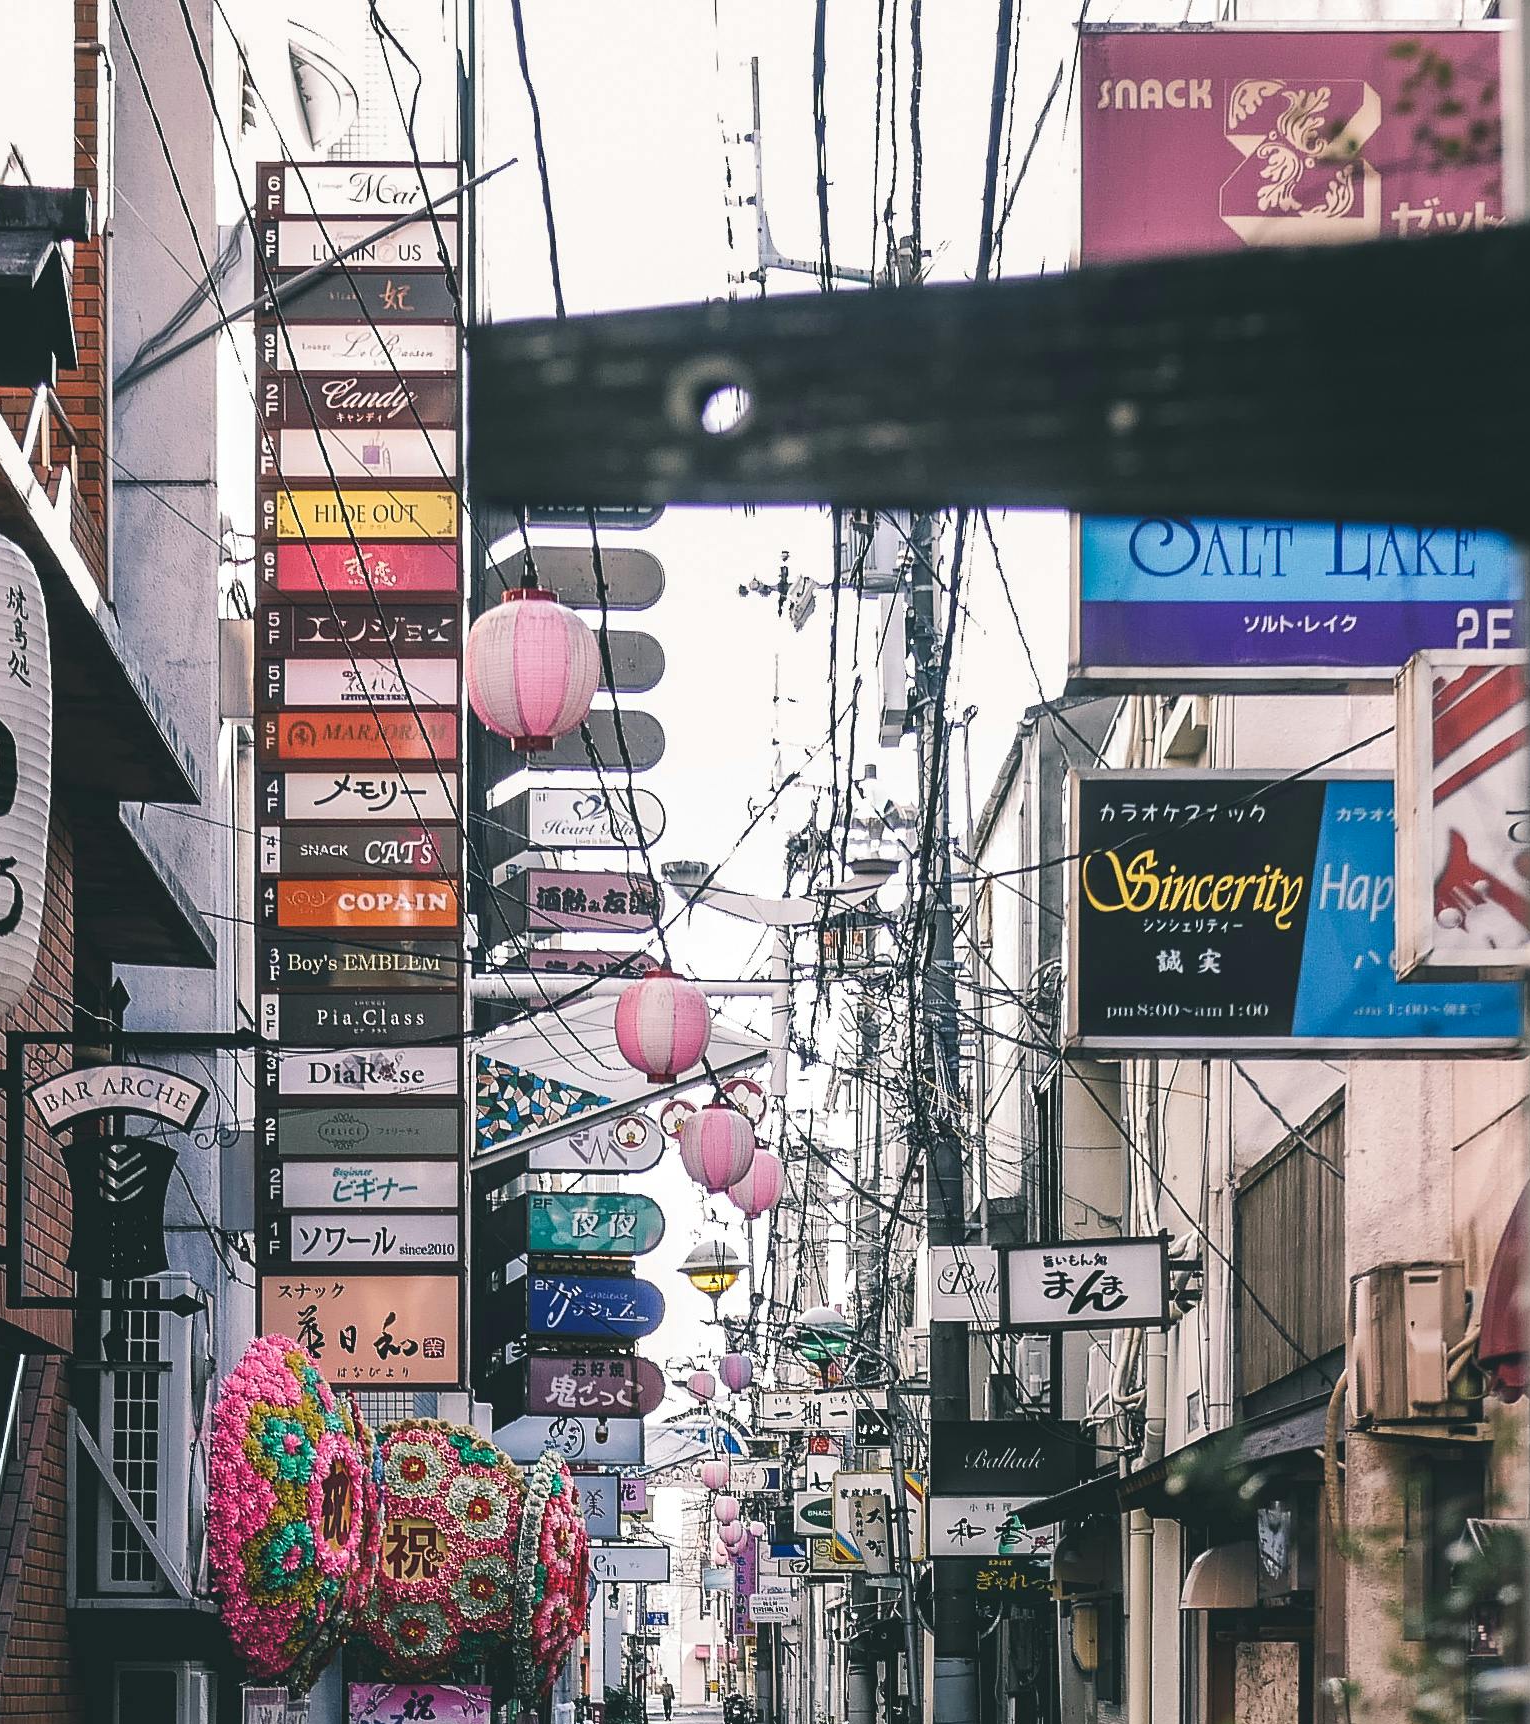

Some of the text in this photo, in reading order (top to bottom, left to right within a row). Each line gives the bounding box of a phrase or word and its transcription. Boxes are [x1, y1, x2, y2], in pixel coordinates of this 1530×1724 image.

[1098, 79, 1212, 110] SNACK
[348, 173, 420, 204] Mai
[321, 379, 419, 419] Candy
[315, 504, 418, 522] HIDE OUT
[1326, 521, 1477, 581] LAKE
[4, 586, 32, 688] 焼鳥処
[298, 617, 454, 642] エンジョイ
[1243, 615, 1357, 633] ソルト・レイク
[1456, 608, 1514, 649] 2F
[314, 775, 426, 811] メモリー
[300, 845, 348, 856] SNACK
[337, 893, 447, 912] COPAIN
[1083, 848, 1303, 931] Sincerity
[1144, 919, 1243, 933] シンシェリティー
[287, 954, 441, 974] Boy's EMBLEM
[1156, 948, 1222, 975] 誠実
[43, 1077, 190, 1112] BAR ARCHE
[333, 1167, 372, 1178] Beginner
[333, 1177, 418, 1202] ビギナー
[299, 1227, 397, 1256] ソワール
[278, 1282, 345, 1299] スナック
[1042, 1270, 1129, 1314] まんま
[337, 1368, 409, 1378] はなびより
[572, 1362, 624, 1377] お好焼
[545, 1374, 645, 1408] 鬼ごっこ
[965, 1448, 1045, 1468] Ballade
[387, 1525, 440, 1580] 祝
[404, 1691, 436, 1720] 祝
